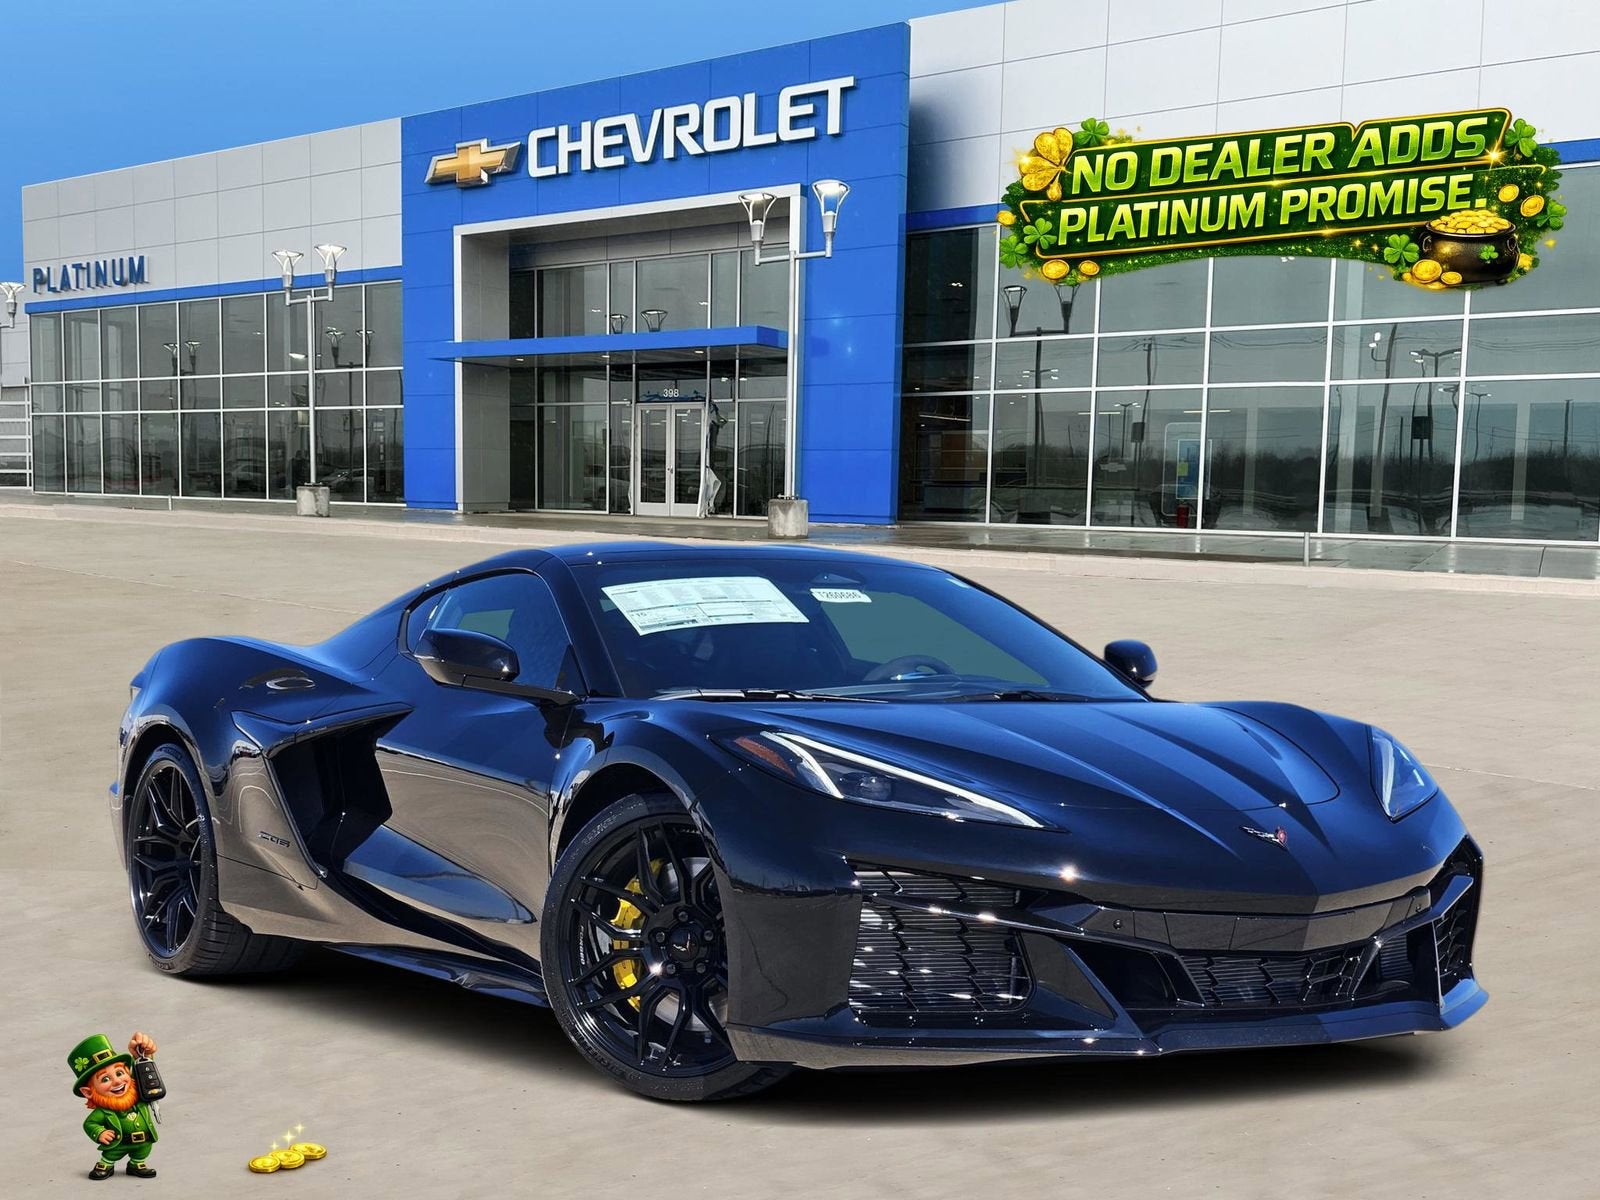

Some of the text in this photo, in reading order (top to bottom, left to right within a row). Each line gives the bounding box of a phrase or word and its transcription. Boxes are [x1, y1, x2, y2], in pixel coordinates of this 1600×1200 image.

[527, 76, 855, 178] CHEVROLET
[32, 255, 146, 294] PLATINUM
[663, 388, 679, 398] 398
